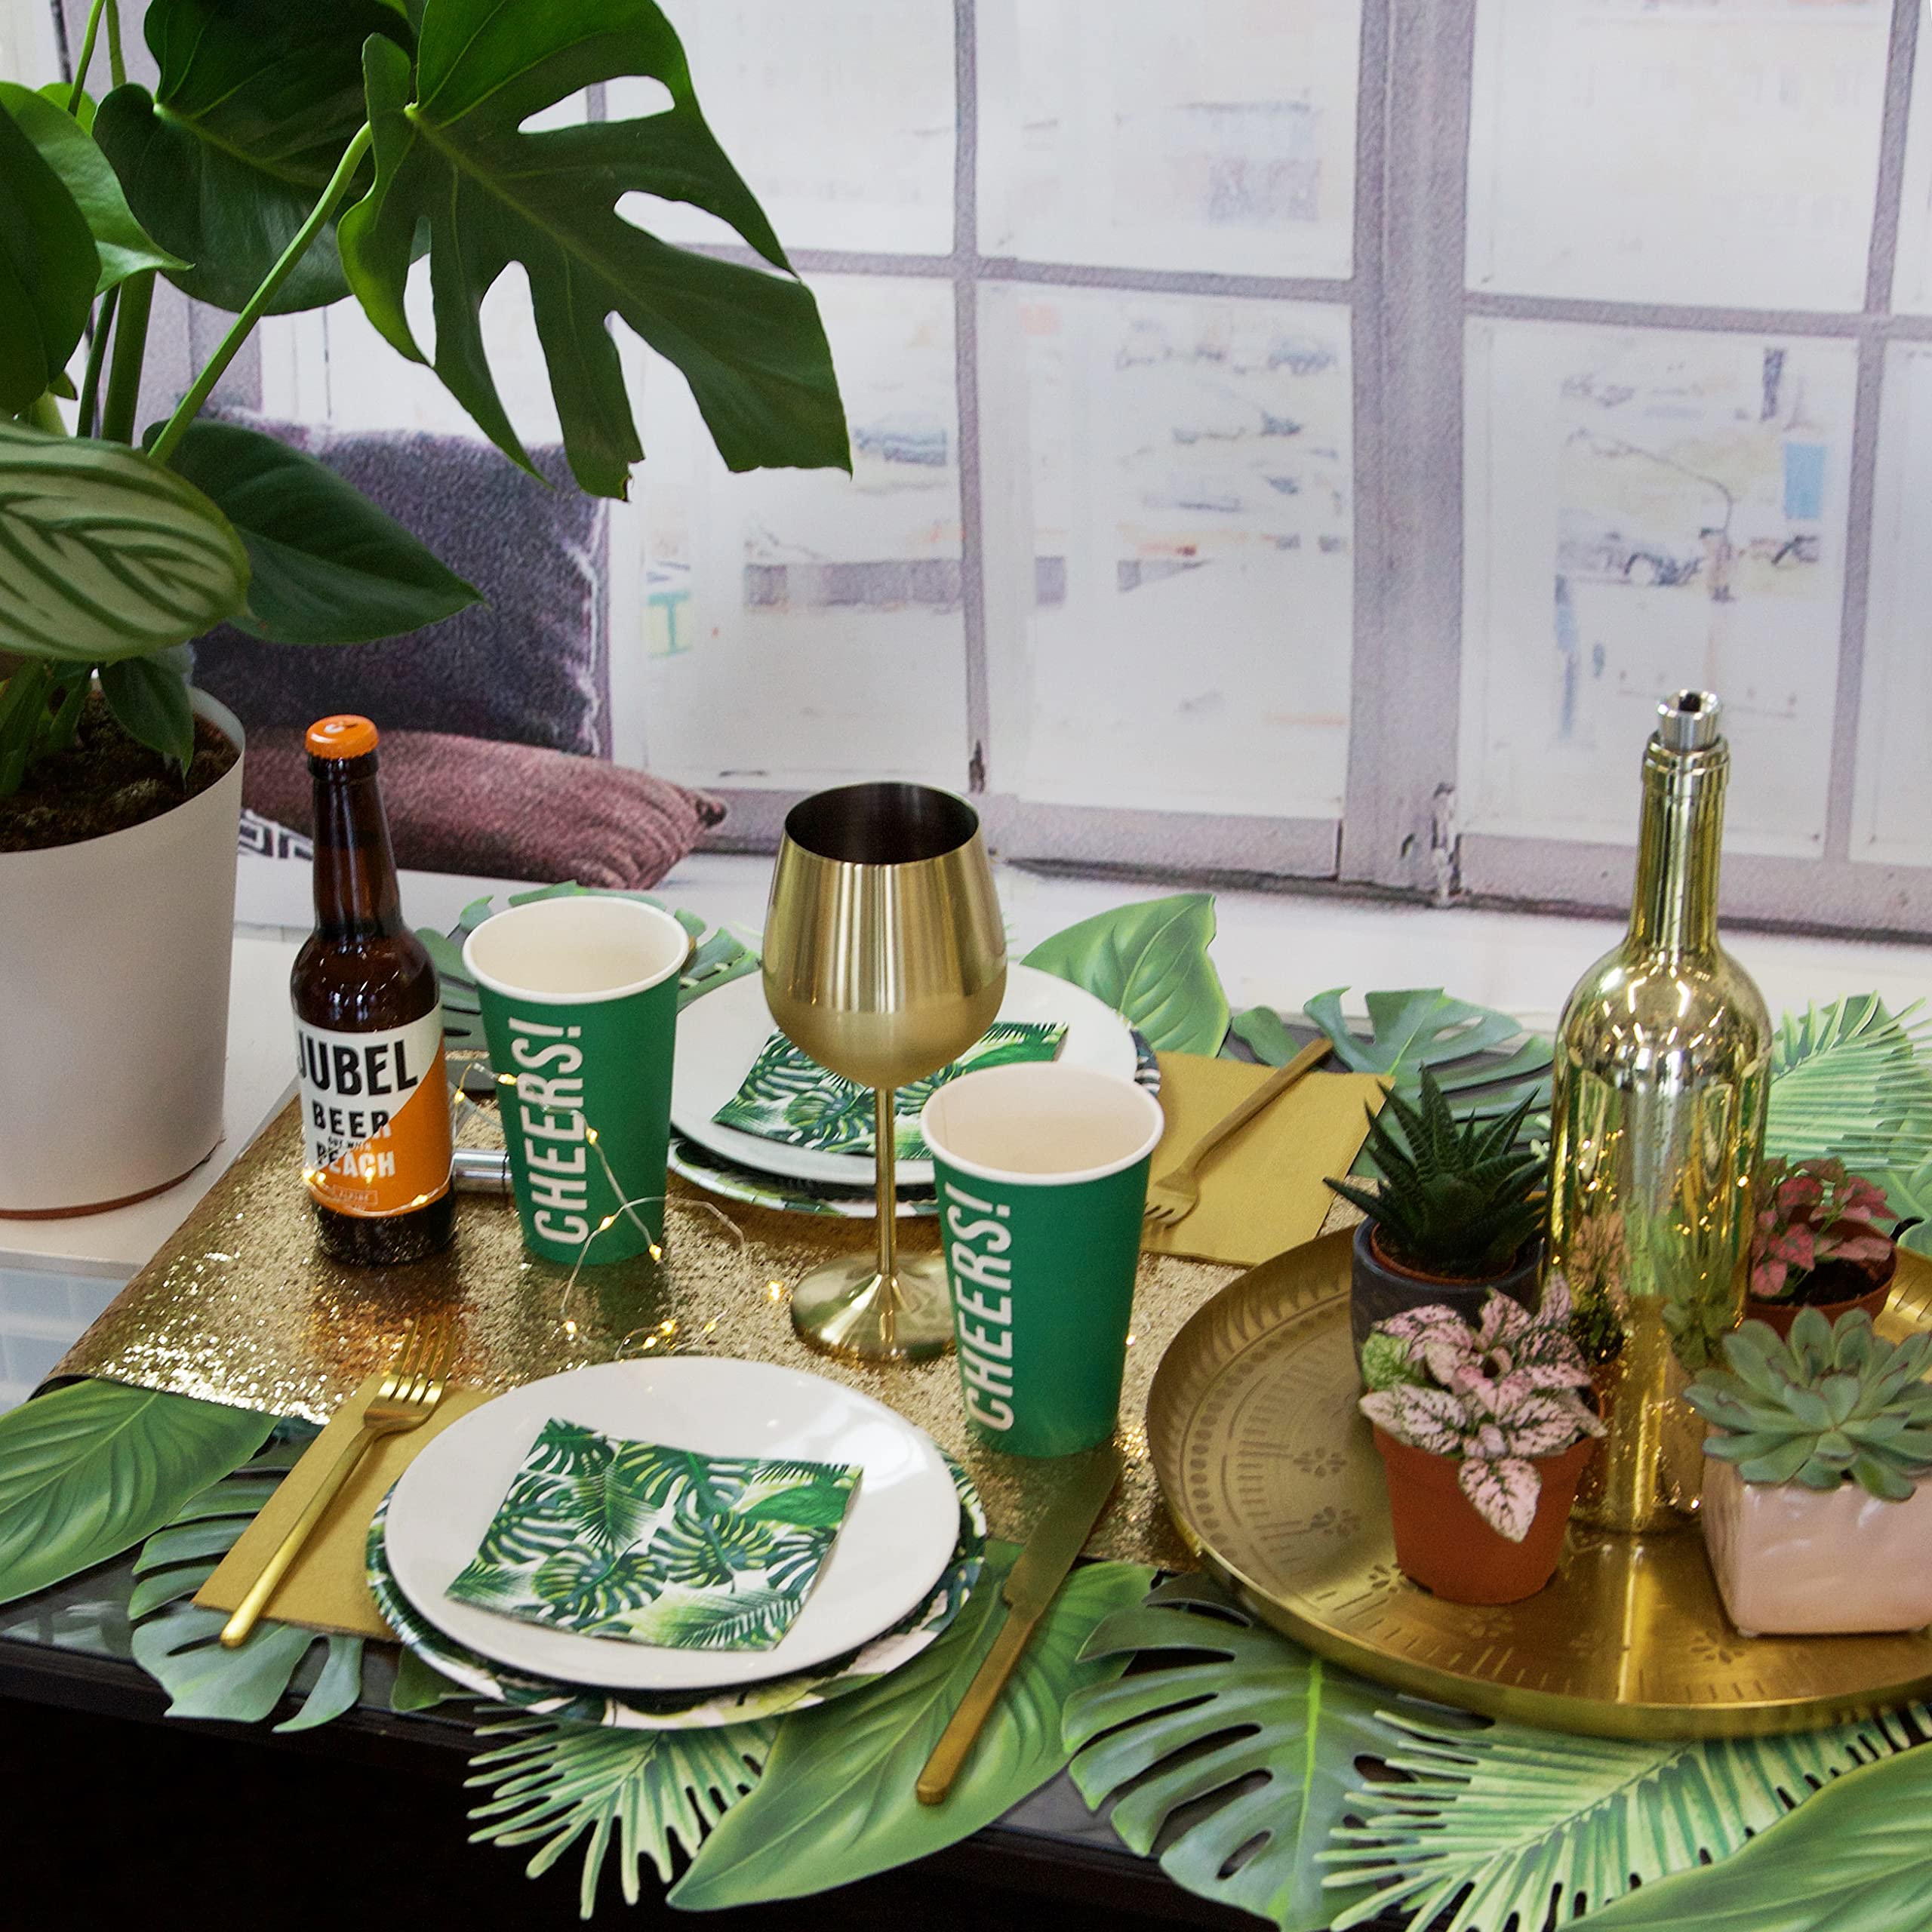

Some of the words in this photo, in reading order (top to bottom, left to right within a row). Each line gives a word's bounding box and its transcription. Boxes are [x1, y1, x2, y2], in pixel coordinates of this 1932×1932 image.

[312, 1099, 392, 1139] BEER
[316, 1141, 395, 1178] PEACH
[509, 1017, 589, 1244] CHEERS!
[945, 1182, 1014, 1432] CHEERS!
